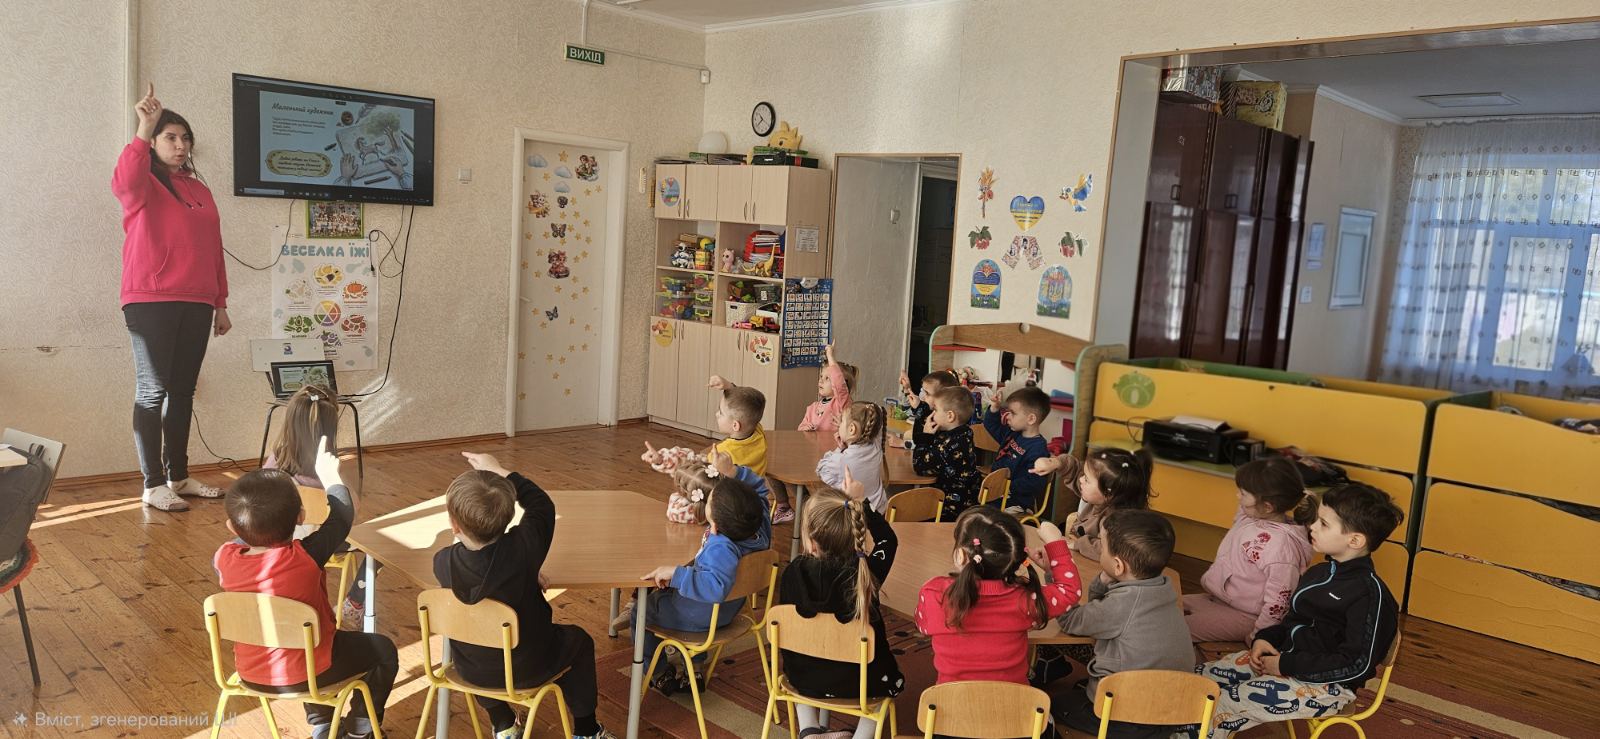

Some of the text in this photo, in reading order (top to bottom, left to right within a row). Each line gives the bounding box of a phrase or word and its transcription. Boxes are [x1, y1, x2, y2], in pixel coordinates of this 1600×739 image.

[570, 48, 602, 63] ВИХІД
[281, 242, 370, 258] ВЕСЕЛКА ЇЖІ
